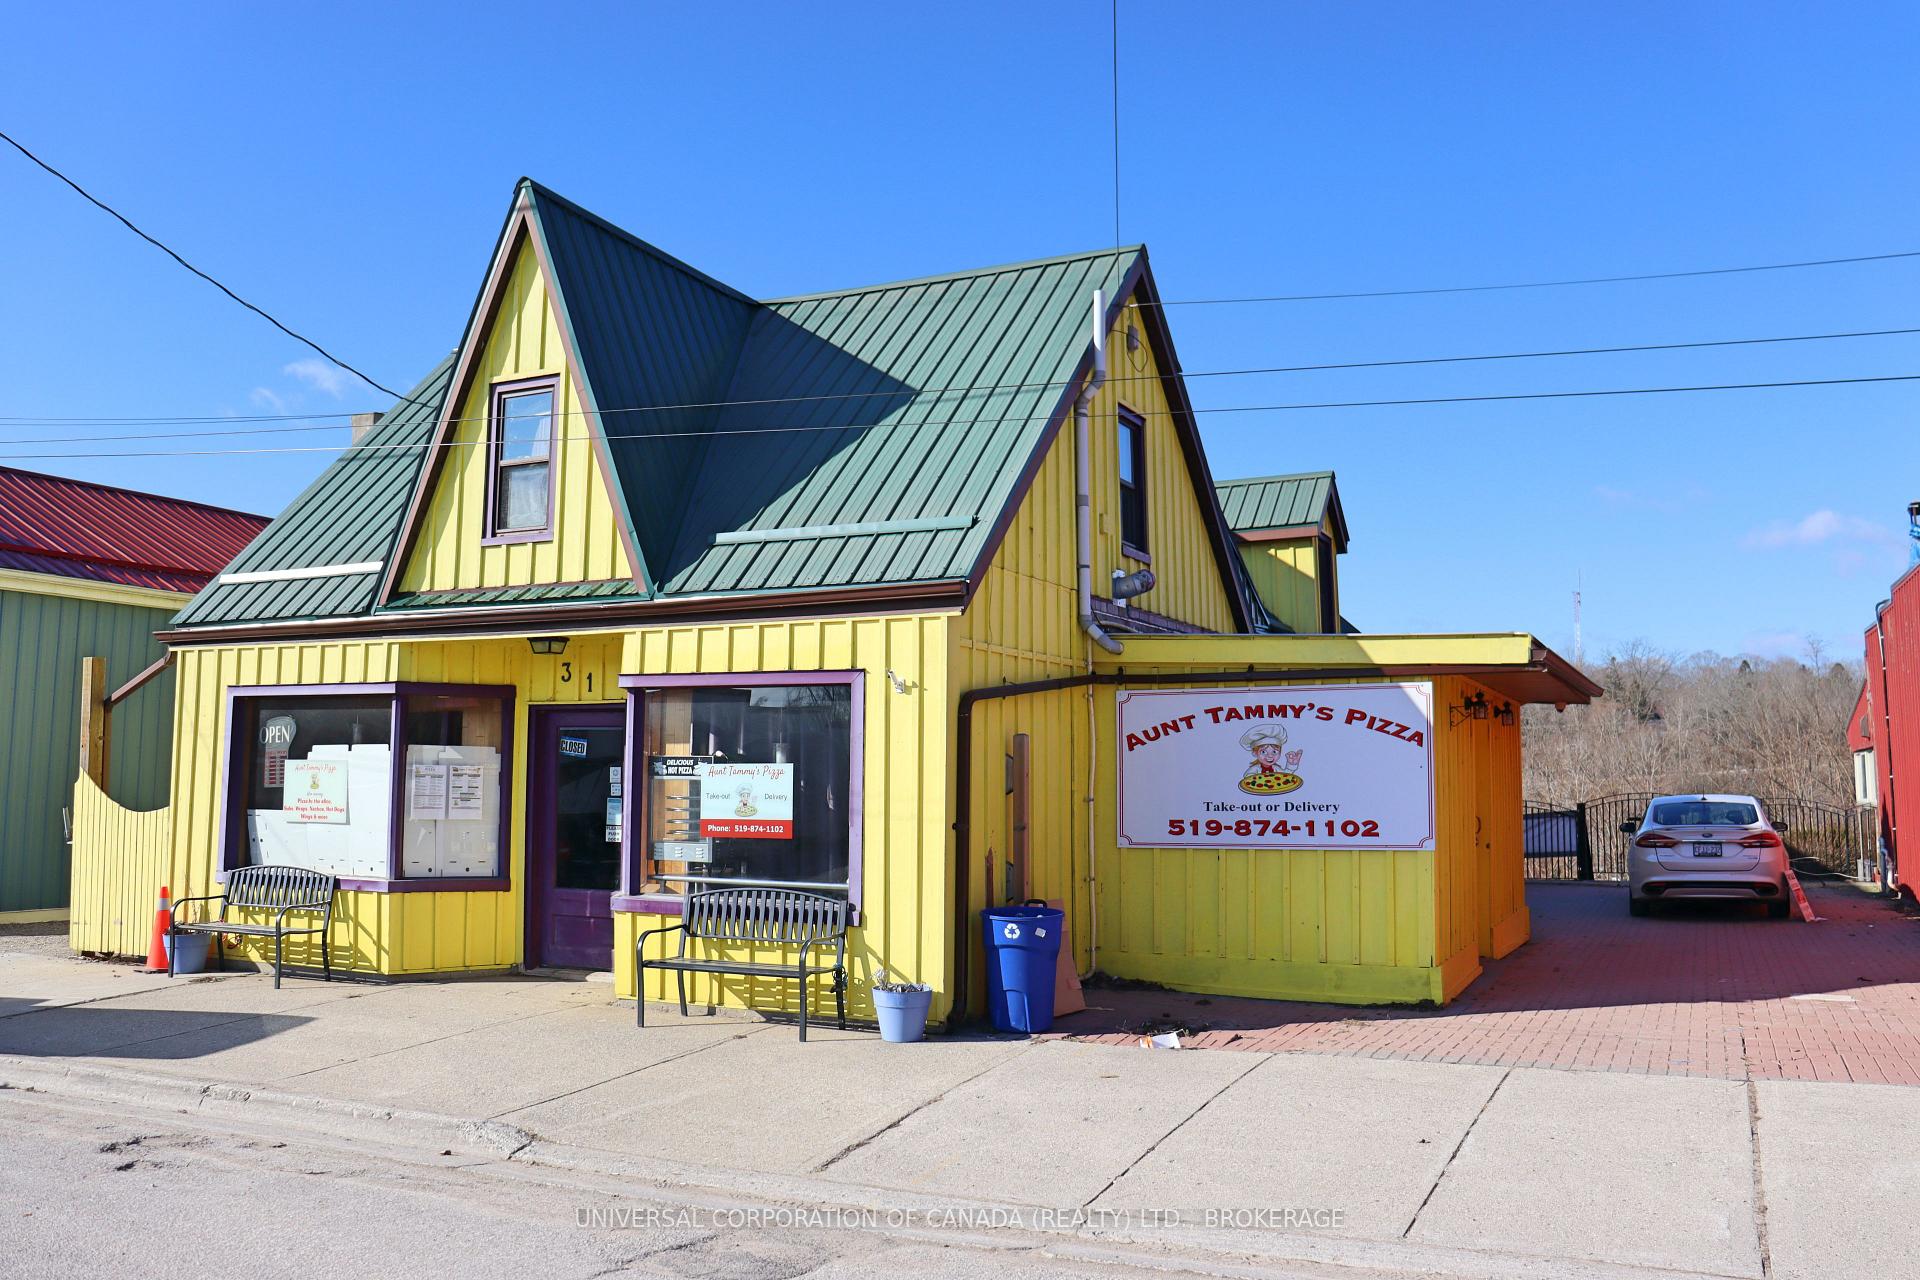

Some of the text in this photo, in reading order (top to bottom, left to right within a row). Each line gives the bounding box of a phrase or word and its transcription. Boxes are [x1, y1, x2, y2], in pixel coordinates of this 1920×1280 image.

[1125, 702, 1424, 752] AUNT TAMMY'S PIZZA
[260, 725, 290, 744] OPEN
[560, 739, 585, 754] CLOSED
[667, 766, 693, 775] HOT PIZZA
[708, 765, 785, 780] Aunt Tammy's Pizza
[706, 792, 731, 800] Take-out
[764, 793, 788, 801] Delivery
[1203, 801, 1340, 815] Take-out or Delivery
[707, 824, 784, 833] Phone: 519-874-1102
[1167, 819, 1380, 837] 519-874-1102
